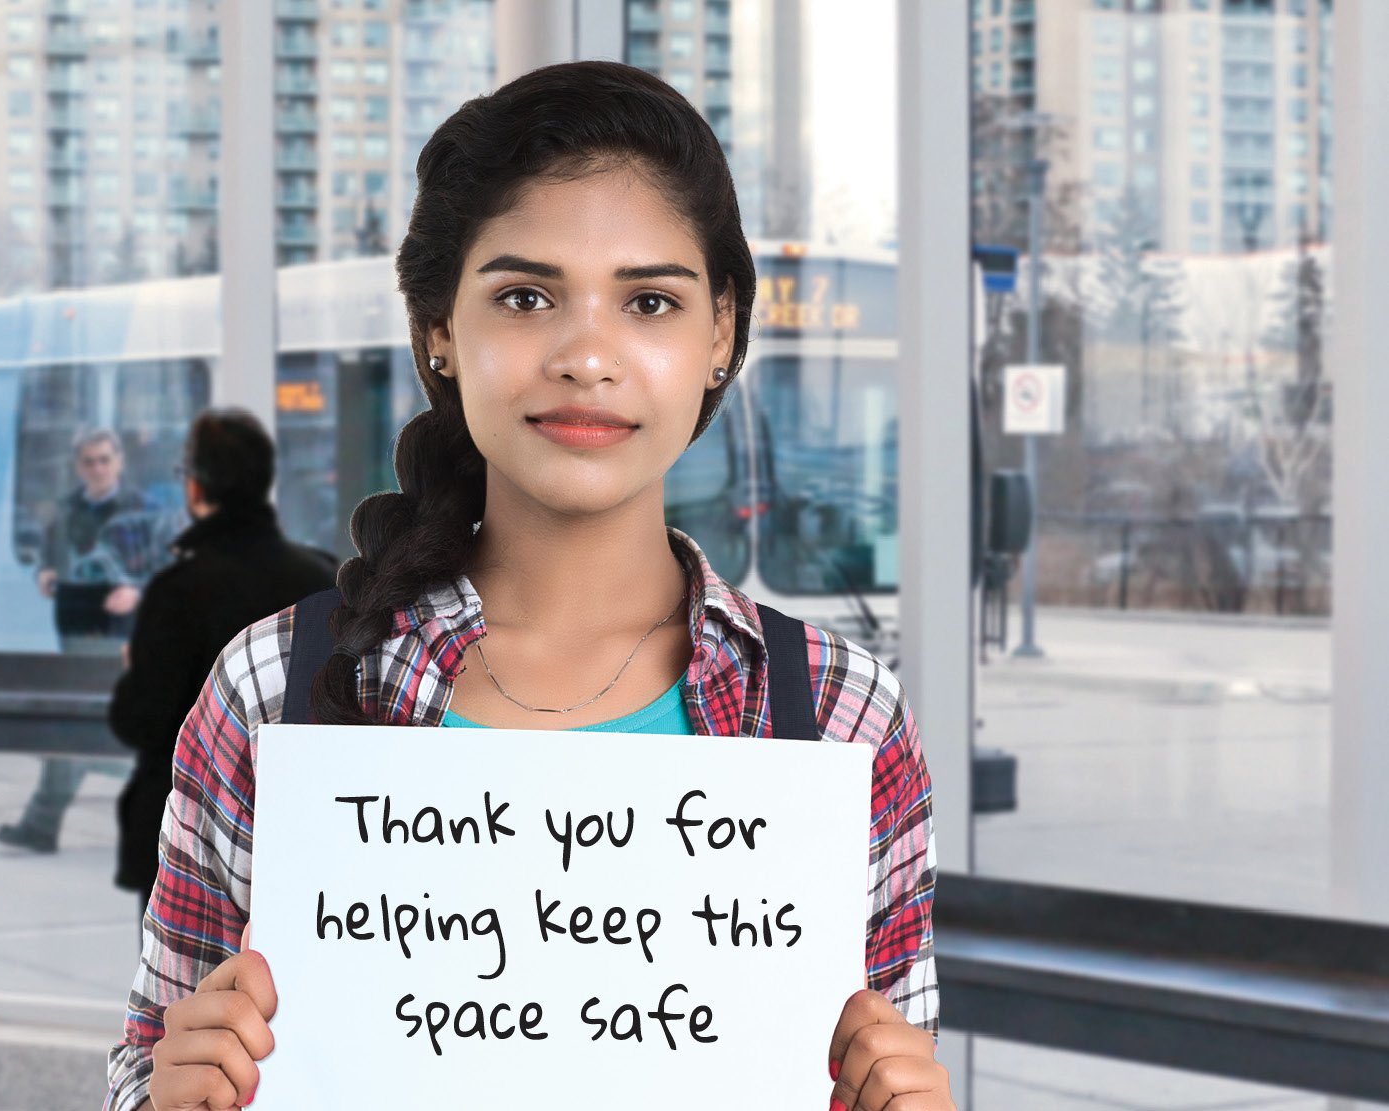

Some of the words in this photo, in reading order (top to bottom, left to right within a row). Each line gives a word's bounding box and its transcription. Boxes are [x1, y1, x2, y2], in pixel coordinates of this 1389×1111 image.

[334, 791, 516, 846] Thank
[545, 806, 635, 873] you
[665, 789, 767, 857] for
[316, 890, 506, 980] helping
[535, 888, 662, 964] keep
[691, 894, 803, 948] this
[395, 993, 549, 1056] space
[580, 983, 719, 1051] safe
